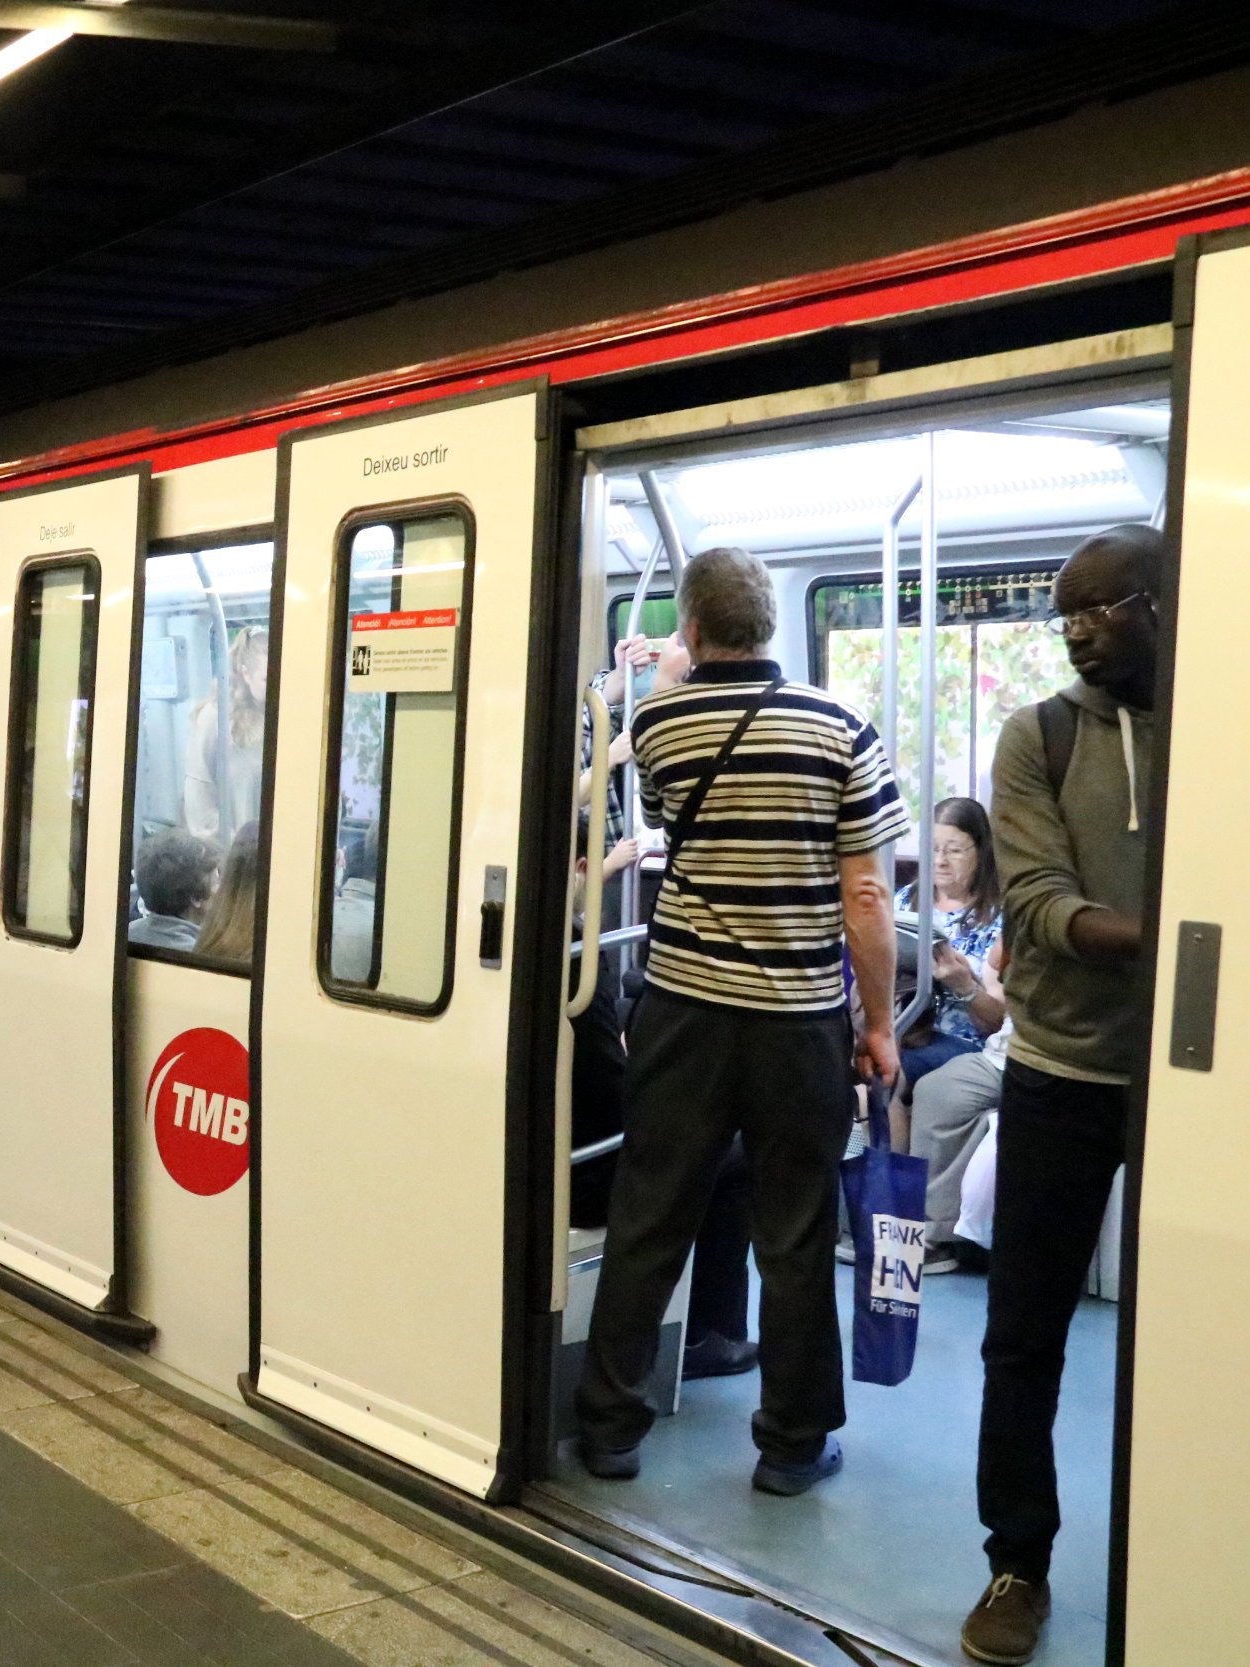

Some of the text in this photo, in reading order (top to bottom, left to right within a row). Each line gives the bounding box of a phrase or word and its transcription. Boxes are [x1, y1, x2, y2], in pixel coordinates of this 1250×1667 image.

[363, 444, 449, 477] Deixeu sortir
[39, 521, 76, 545] Deje salir
[172, 1081, 250, 1147] TMB
